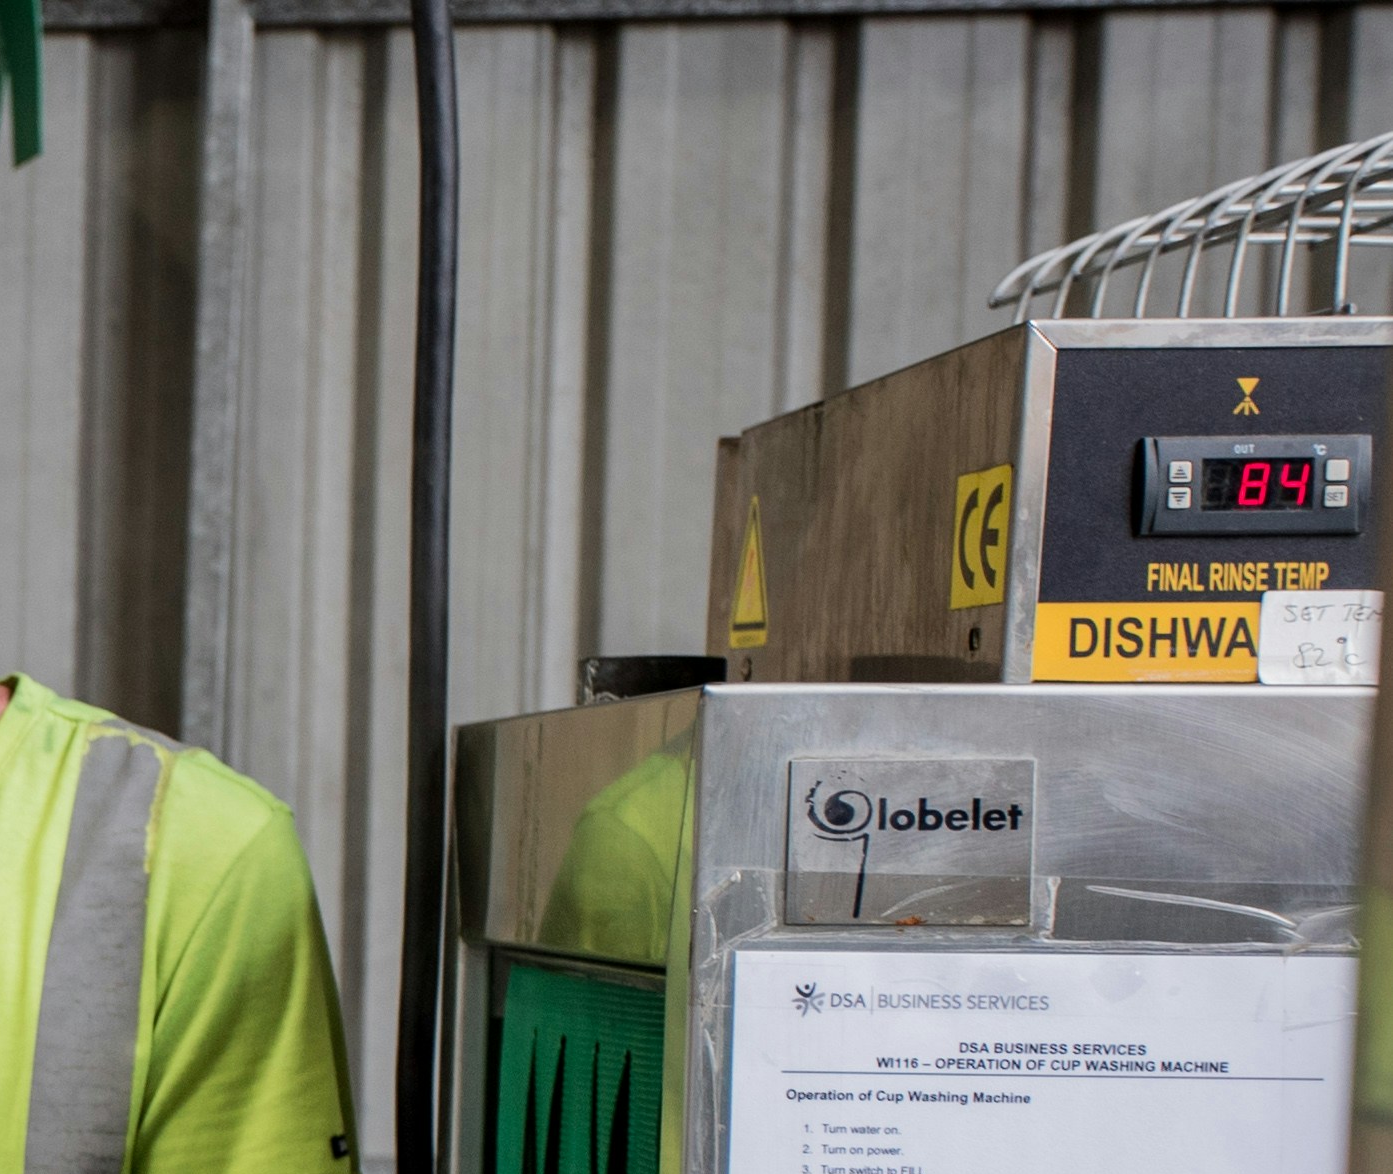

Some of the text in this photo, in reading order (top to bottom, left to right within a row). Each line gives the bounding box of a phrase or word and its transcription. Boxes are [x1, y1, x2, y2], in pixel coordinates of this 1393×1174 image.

[1233, 444, 1256, 454] OUT
[1236, 462, 1311, 506] 84
[1326, 491, 1345, 502] SET
[1147, 562, 1330, 592] FINAL RINSE TEMP
[1283, 604, 1335, 623] SET
[1068, 615, 1257, 660] DISHWA
[829, 992, 1049, 1011] DSA BUSINESS SERVICES
[959, 1042, 1147, 1056] DSA BUSINESS SERVICES
[935, 1058, 1021, 1070] OPERATION
[1025, 1059, 1046, 1071] OF
[1050, 1059, 1081, 1071] CUP
[1085, 1060, 1156, 1072] WASHING
[1160, 1061, 1229, 1073] MACHINE
[785, 1088, 1031, 1106] Operation of Cup Washing Machine
[804, 1123, 902, 1135] 1. Turn water on.
[802, 1144, 903, 1157] 2. Turn on power.
[801, 1164, 812, 1174] 3.
[820, 1164, 846, 1174] Turn
